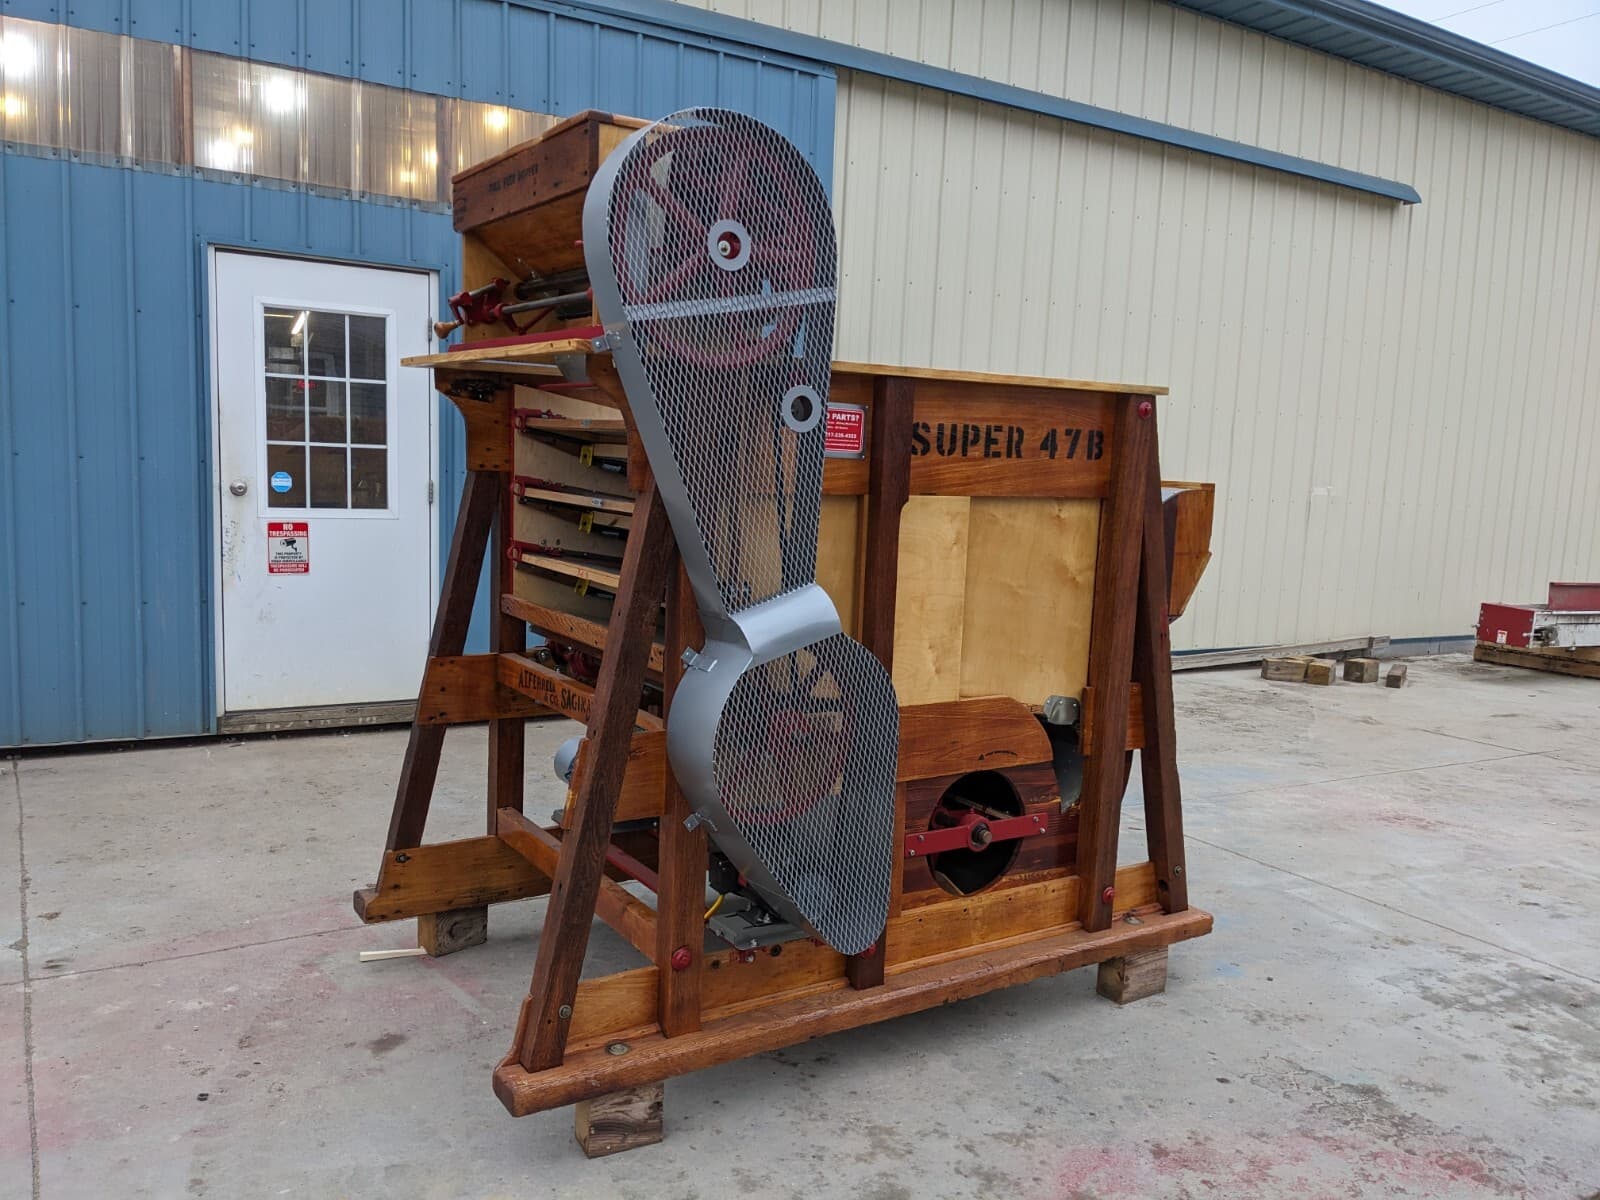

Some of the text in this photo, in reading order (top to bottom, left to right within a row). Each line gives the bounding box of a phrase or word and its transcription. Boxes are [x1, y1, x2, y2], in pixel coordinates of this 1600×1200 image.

[831, 412, 860, 421] PARTS?
[911, 421, 1105, 461] SUPER 47B
[282, 523, 294, 531] NO
